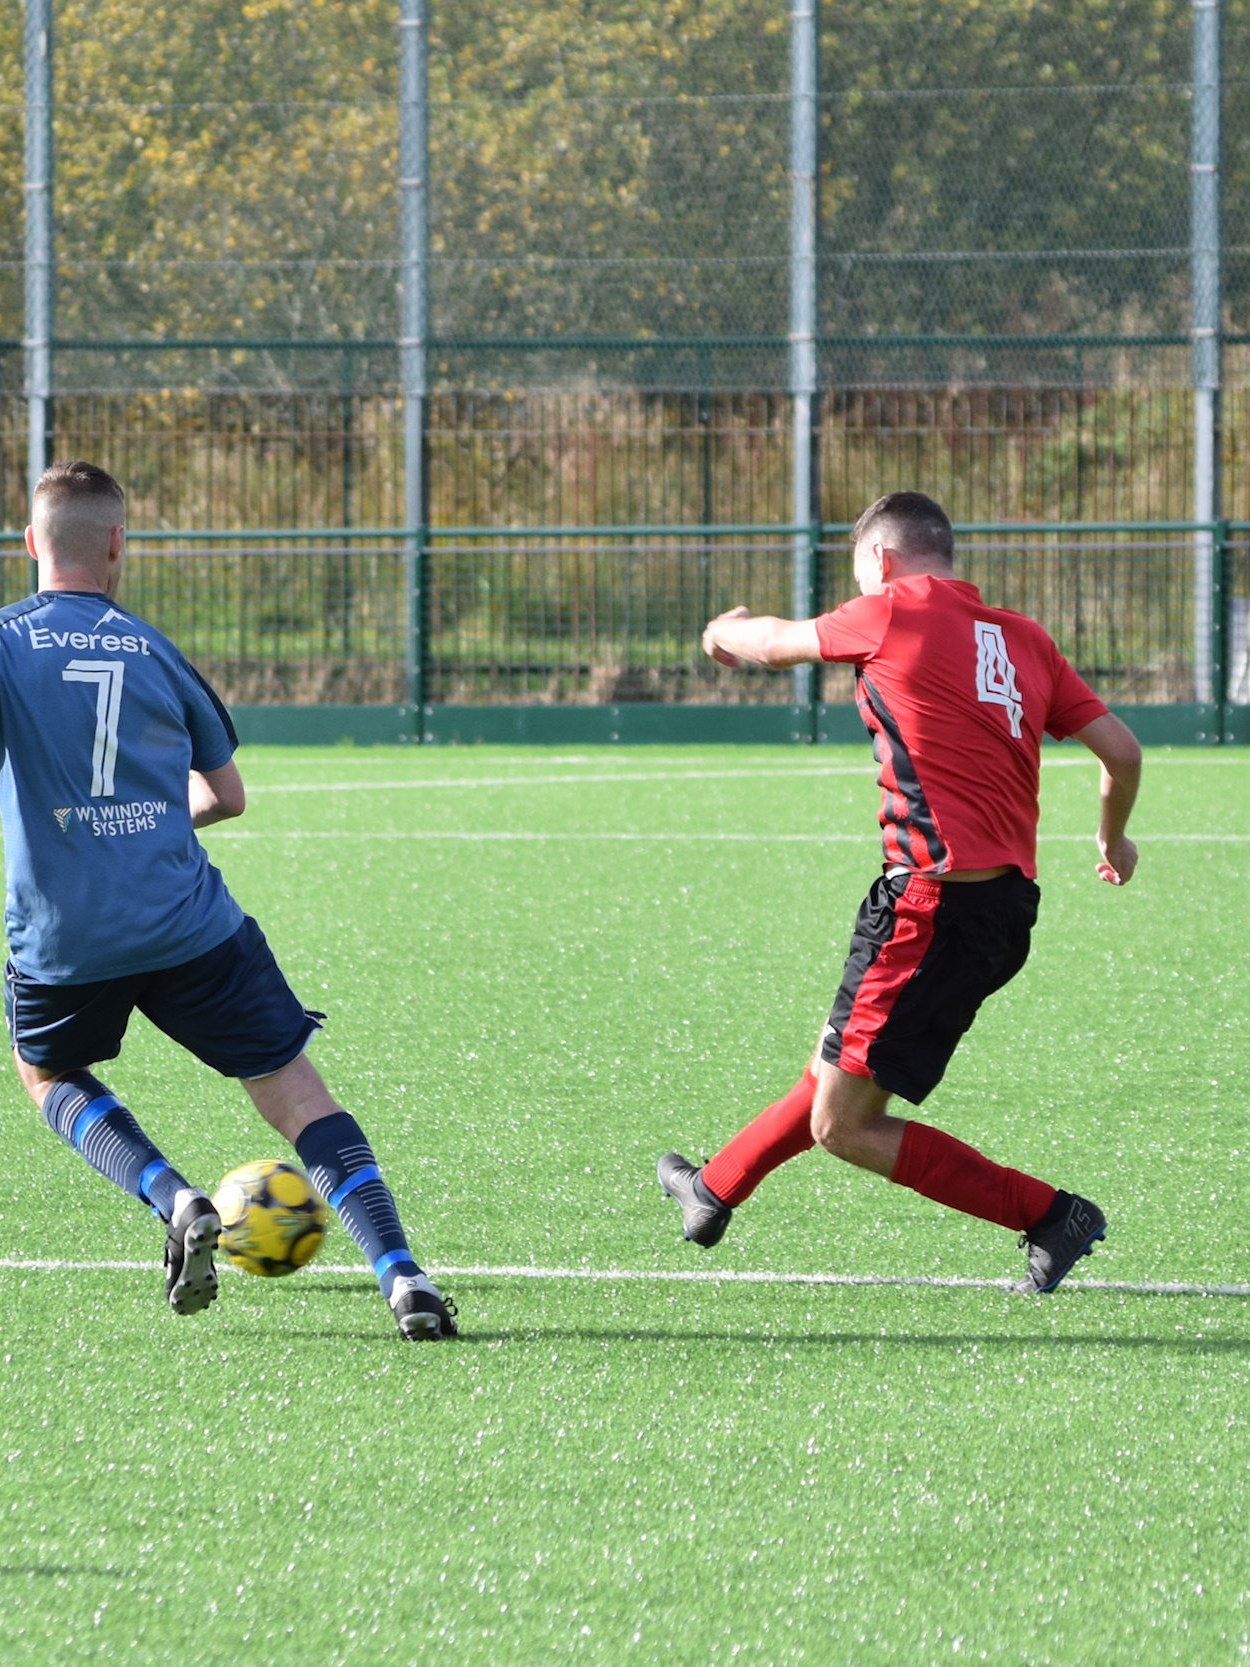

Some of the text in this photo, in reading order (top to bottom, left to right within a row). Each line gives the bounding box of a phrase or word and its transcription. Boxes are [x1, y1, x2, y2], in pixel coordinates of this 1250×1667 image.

[29, 628, 150, 655] Everest
[975, 620, 1023, 739] 4
[62, 659, 125, 797] 7
[75, 801, 167, 821] W2 WINDOW
[92, 815, 156, 836] SYSTEMS
